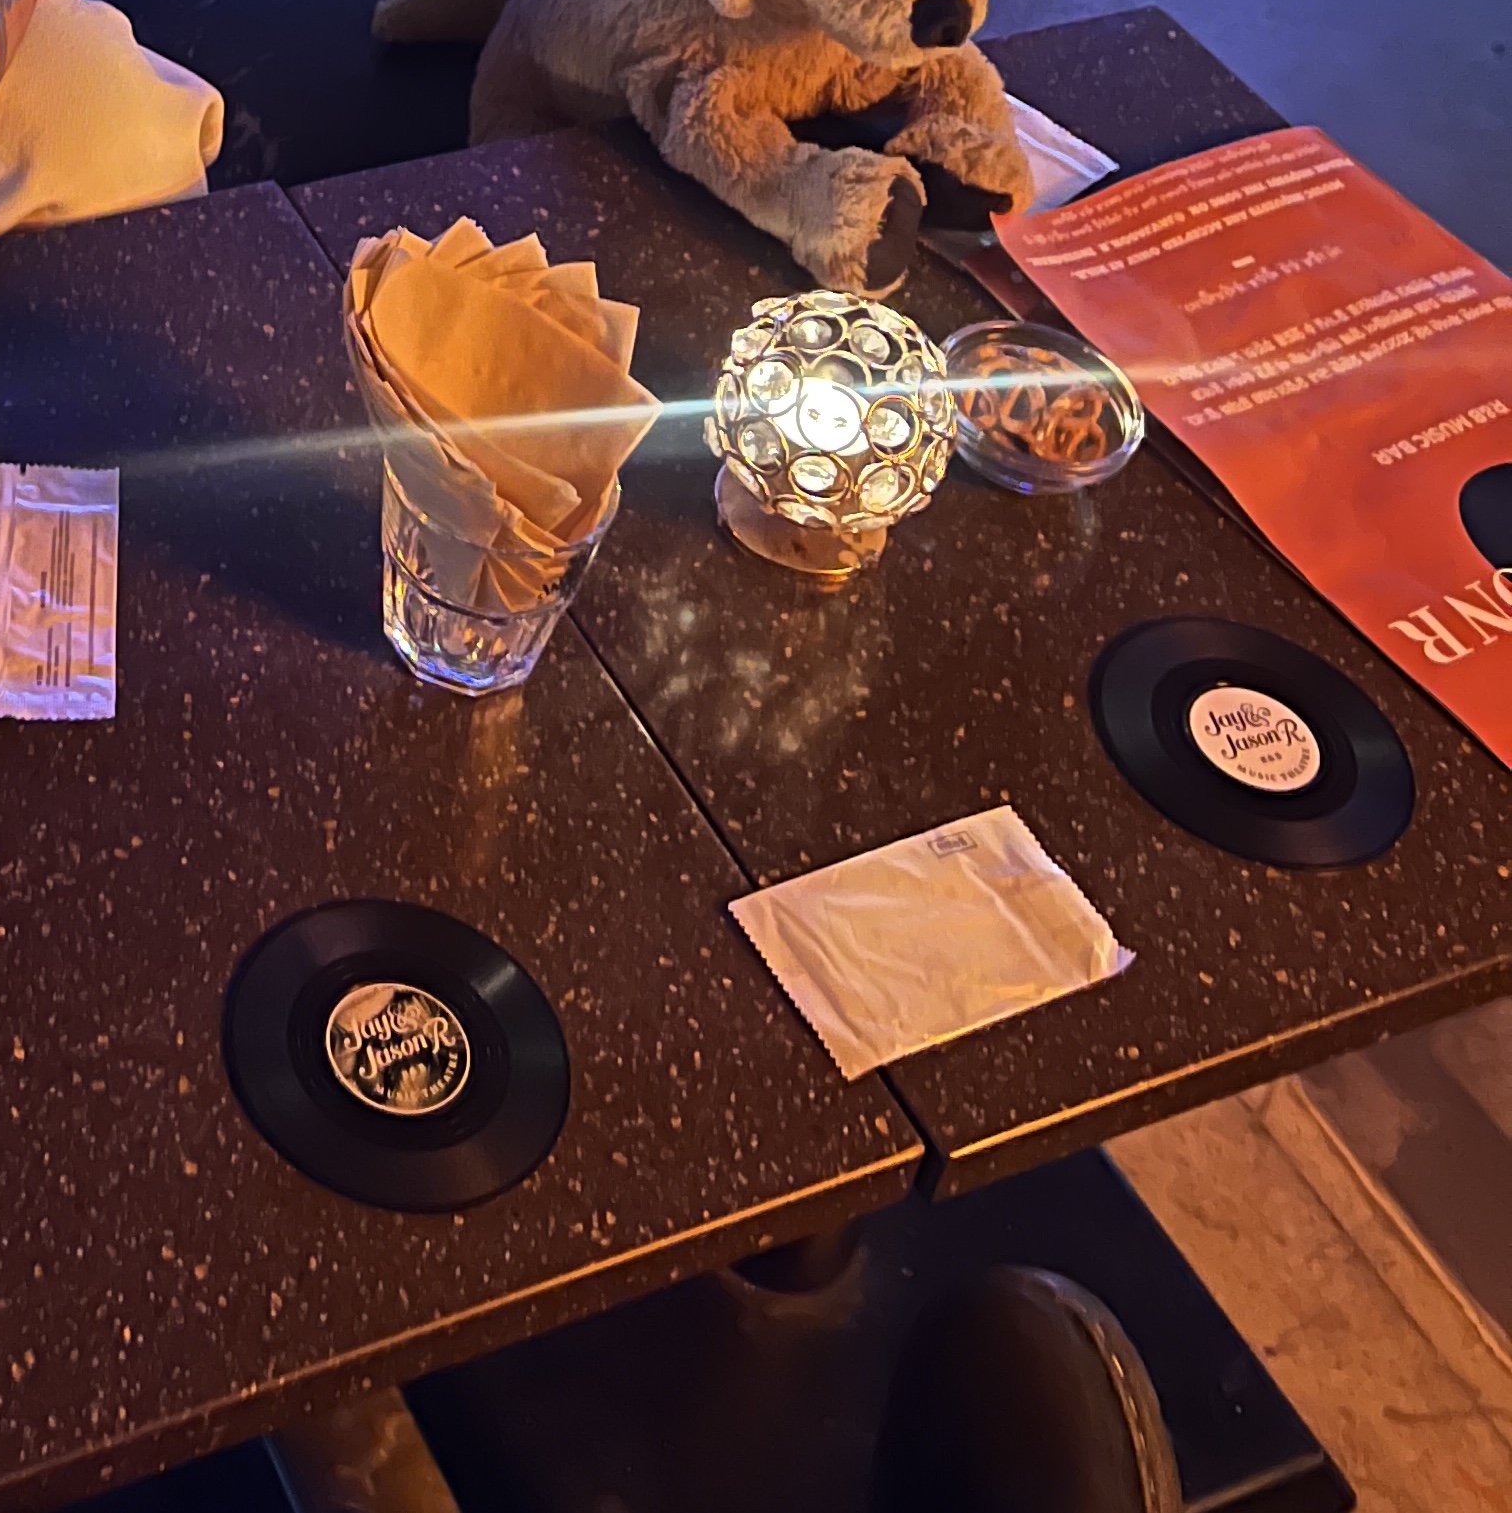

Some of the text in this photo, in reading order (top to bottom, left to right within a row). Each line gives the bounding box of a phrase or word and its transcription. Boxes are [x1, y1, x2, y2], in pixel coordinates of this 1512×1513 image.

[1372, 400, 1509, 464] R&B MUSIC BAR
